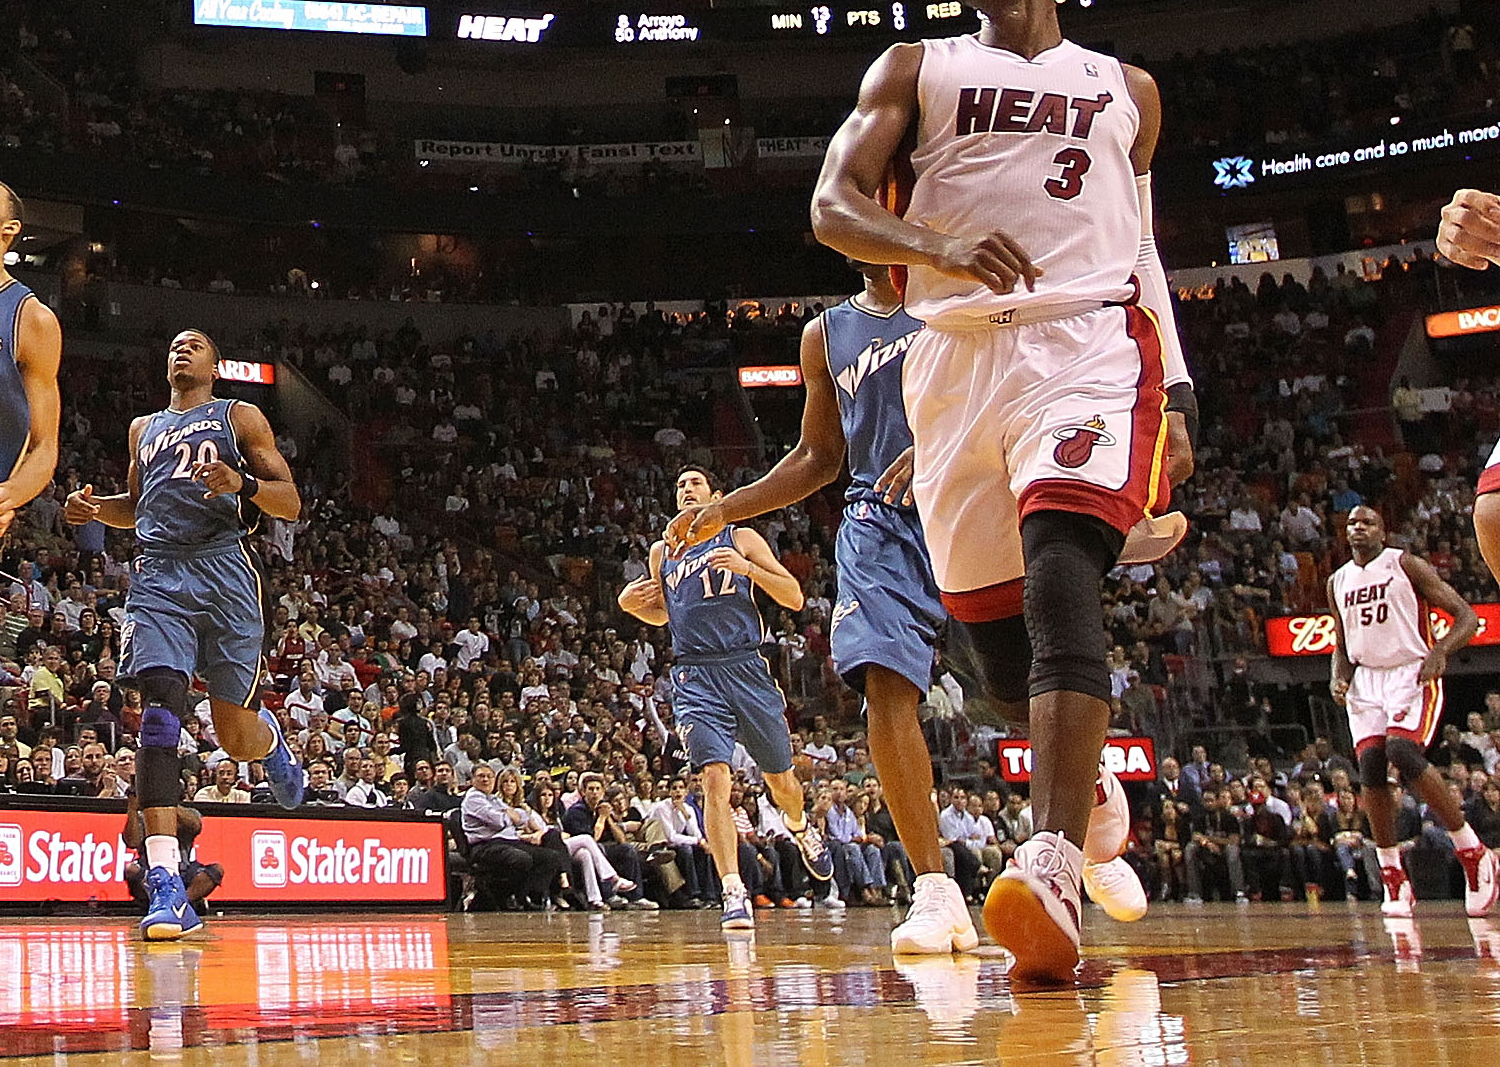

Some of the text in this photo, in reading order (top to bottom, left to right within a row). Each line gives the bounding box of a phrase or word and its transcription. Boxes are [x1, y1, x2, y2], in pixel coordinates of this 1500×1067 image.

[811, 6, 832, 22] 13
[846, 10, 881, 27] PTS
[891, 1, 904, 17] 0
[926, 1, 962, 20] REB
[457, 13, 555, 43] HEAT
[617, 13, 686, 31] 8 Arroyo
[771, 13, 803, 30] MIN
[893, 15, 906, 31] 0
[614, 26, 699, 42] 50 Anthony
[955, 88, 1114, 140] HEAT
[421, 142, 696, 161] Report Unruly Fans! Text
[1261, 152, 1312, 177] Health
[1315, 150, 1350, 169] care
[1354, 138, 1385, 162] and
[1388, 142, 1409, 156] so
[1412, 128, 1454, 153] much
[1043, 146, 1092, 201] 3
[741, 369, 797, 383] BACARDI
[698, 567, 737, 599] 12
[1344, 577, 1394, 608] HEAT
[1360, 602, 1389, 626] 50
